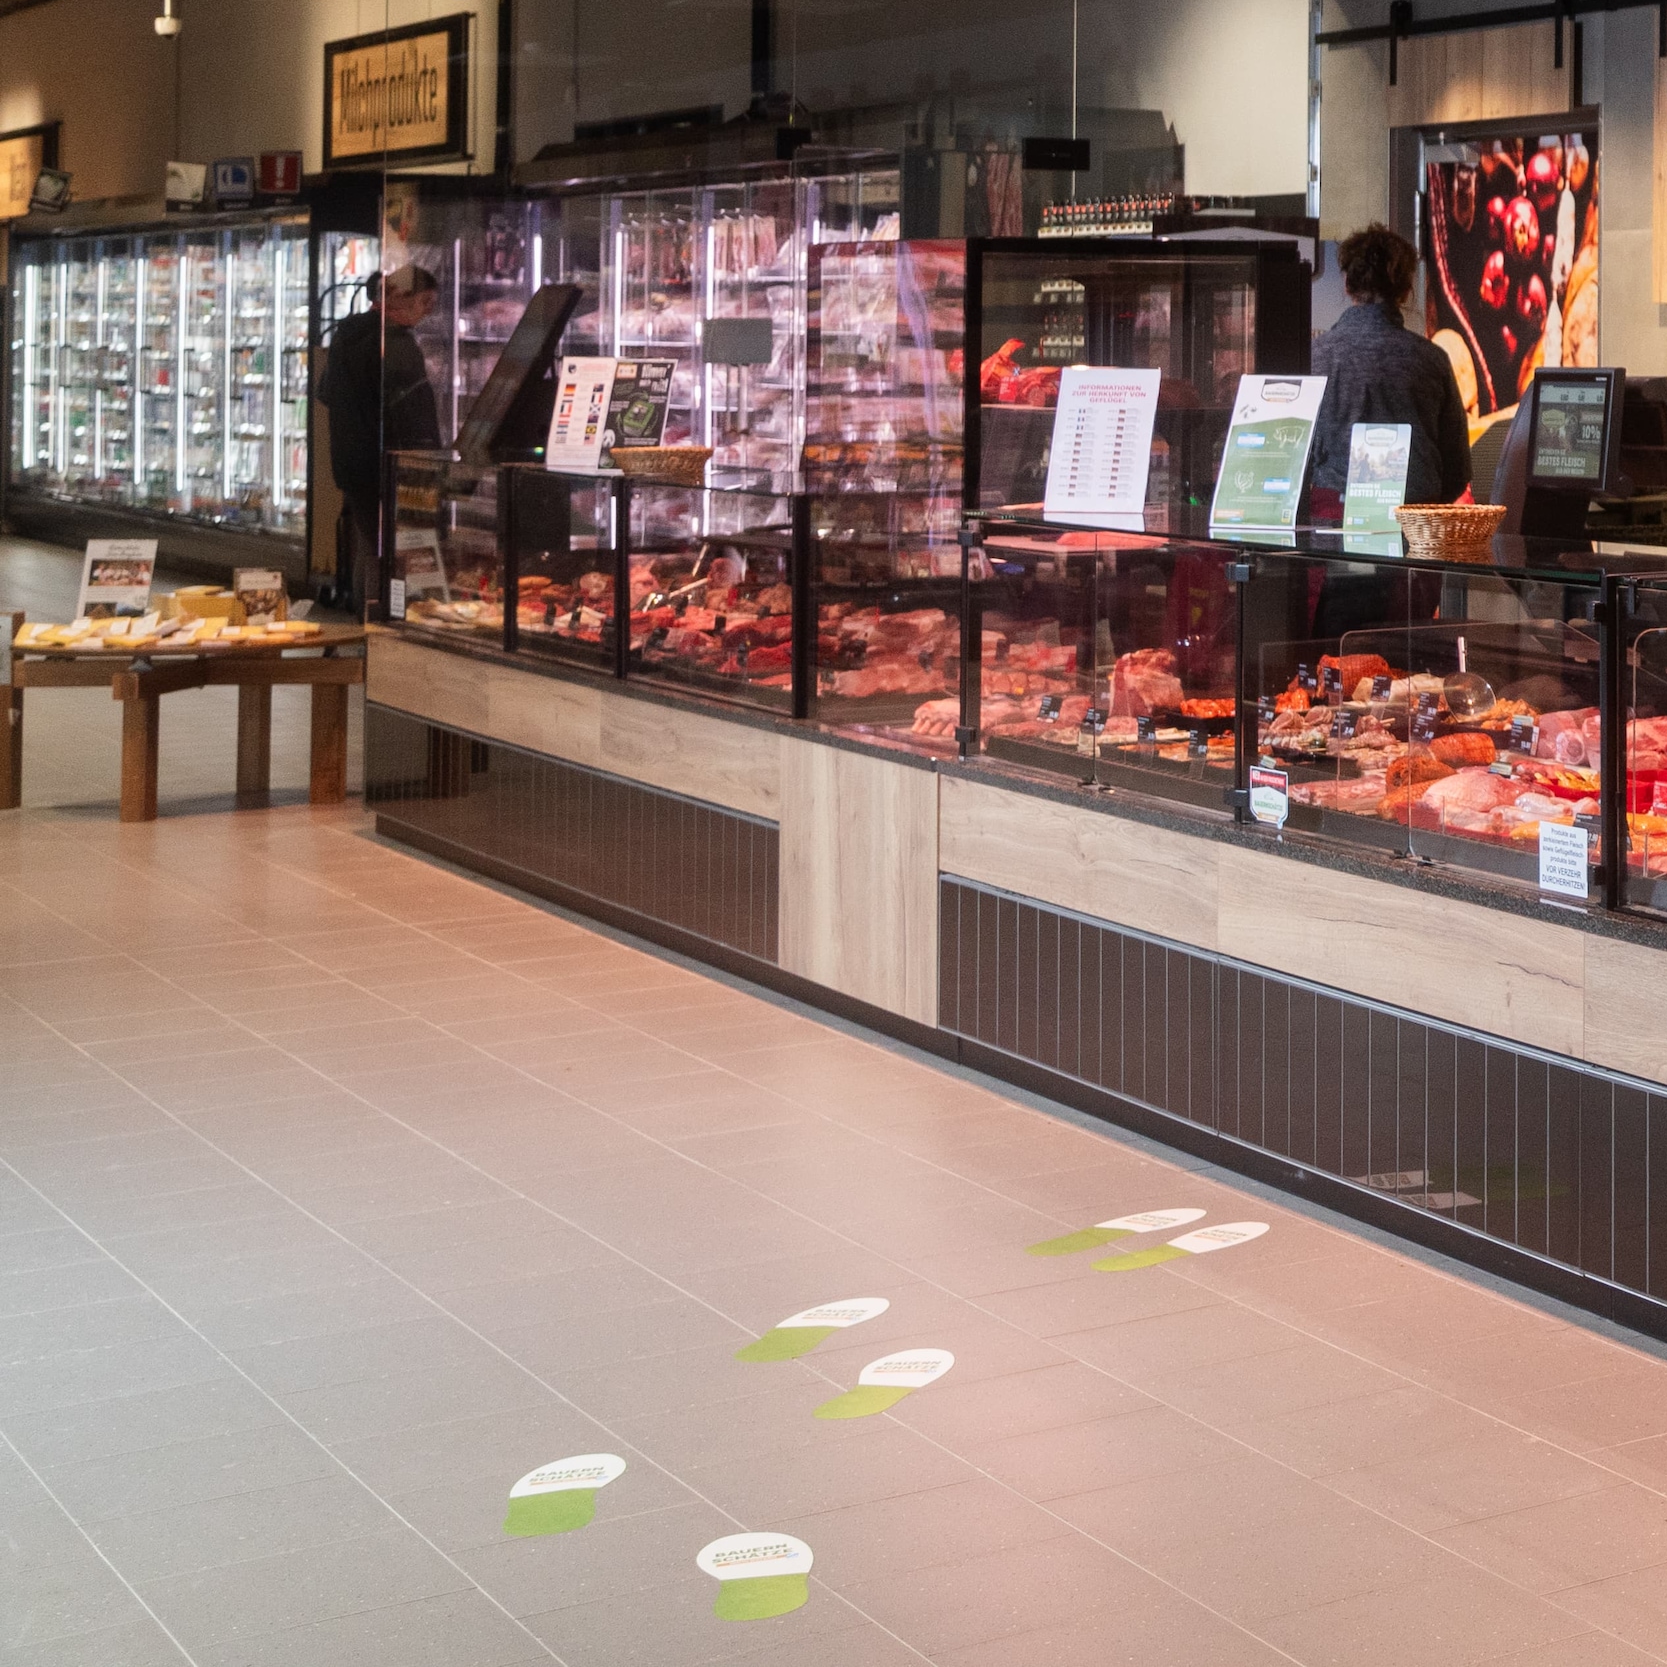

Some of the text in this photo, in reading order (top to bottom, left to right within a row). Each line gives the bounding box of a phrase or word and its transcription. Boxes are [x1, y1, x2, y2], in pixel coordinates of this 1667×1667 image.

[339, 52, 439, 148] Milchprodukte
[1582, 425, 1601, 440] 10%
[1561, 457, 1585, 468] FLEISCH
[1546, 864, 1581, 879] VOR VERZEHR
[529, 1470, 607, 1482] SCHÄTZE
[534, 1466, 605, 1477] BAUERN
[712, 1547, 794, 1564] SCHÄTZE
[714, 1543, 788, 1558] BAUERN
